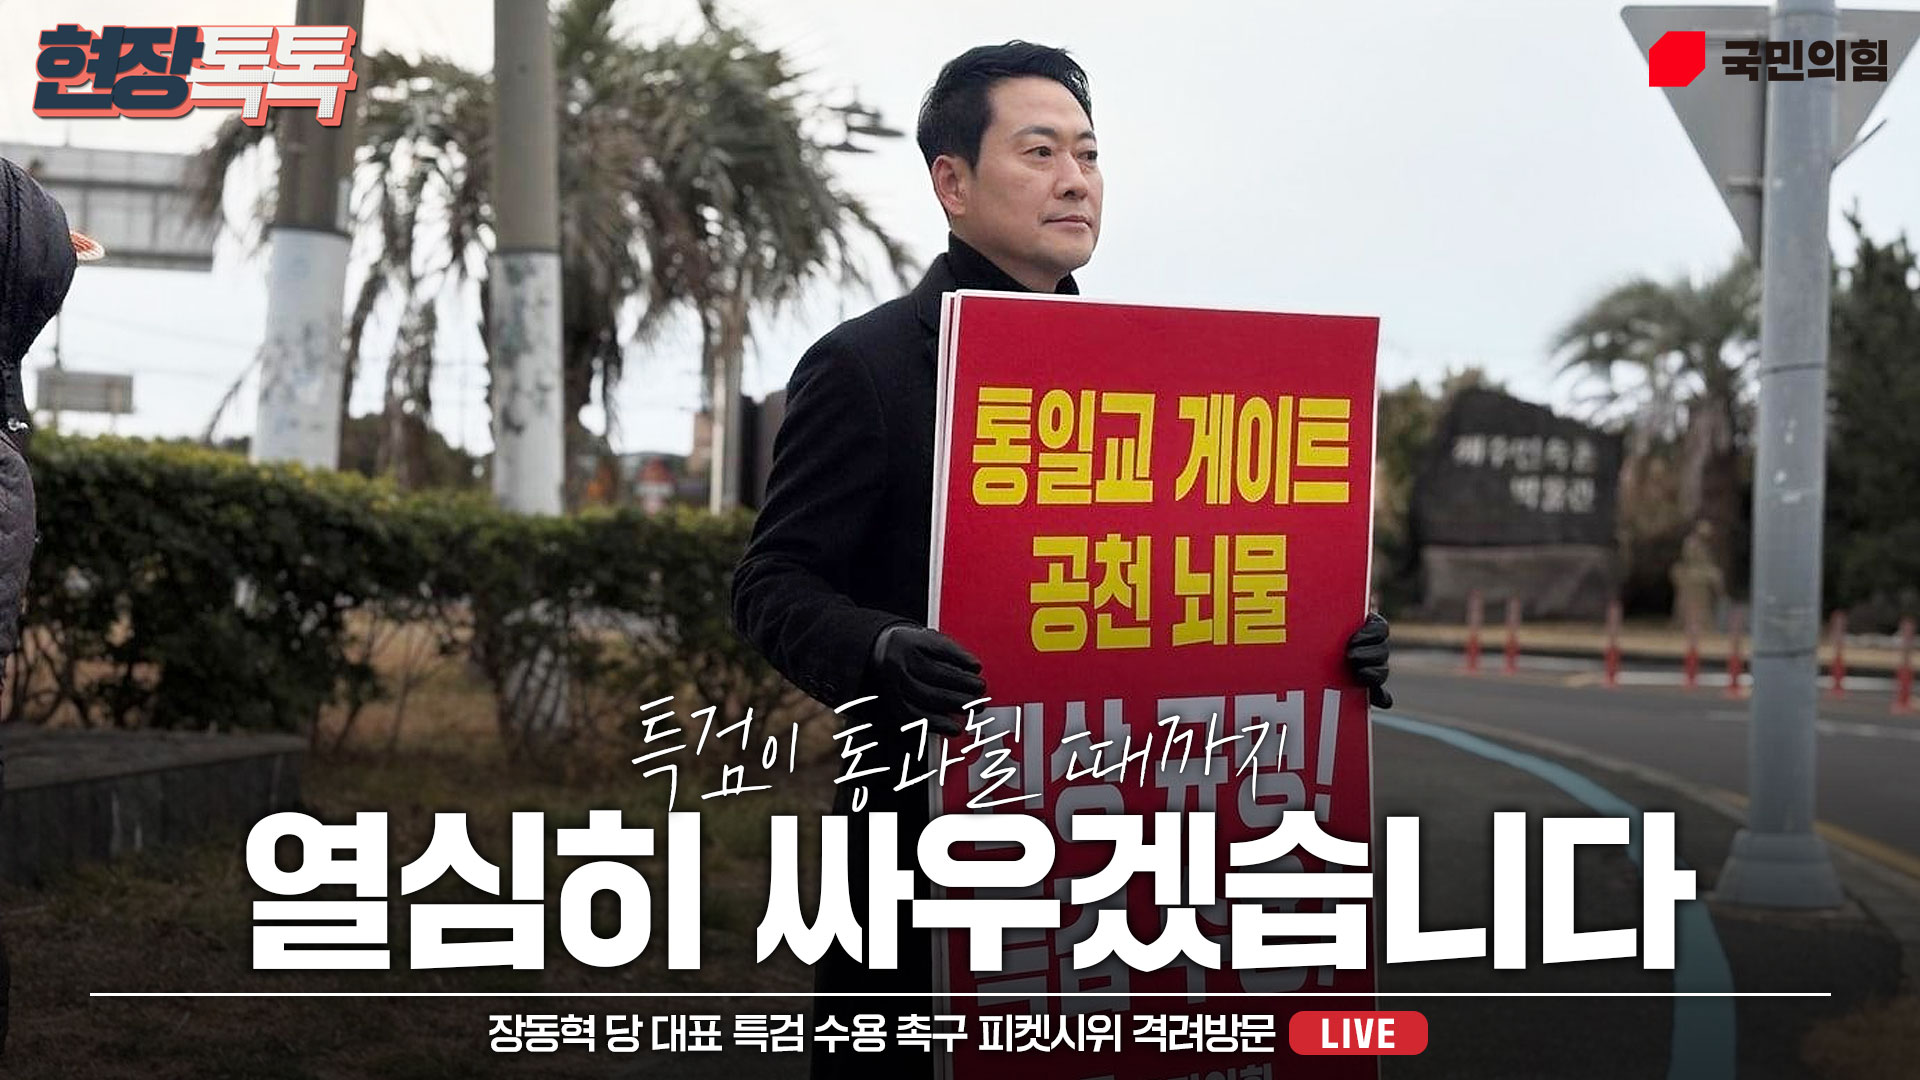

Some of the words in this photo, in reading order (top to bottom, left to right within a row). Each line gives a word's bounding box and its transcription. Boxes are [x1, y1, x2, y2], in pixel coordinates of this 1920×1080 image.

[972, 387, 1156, 505] 통일교
[1175, 394, 1351, 505] 게이트
[1030, 533, 1151, 651] 공천
[1172, 535, 1288, 647] 뇌물
